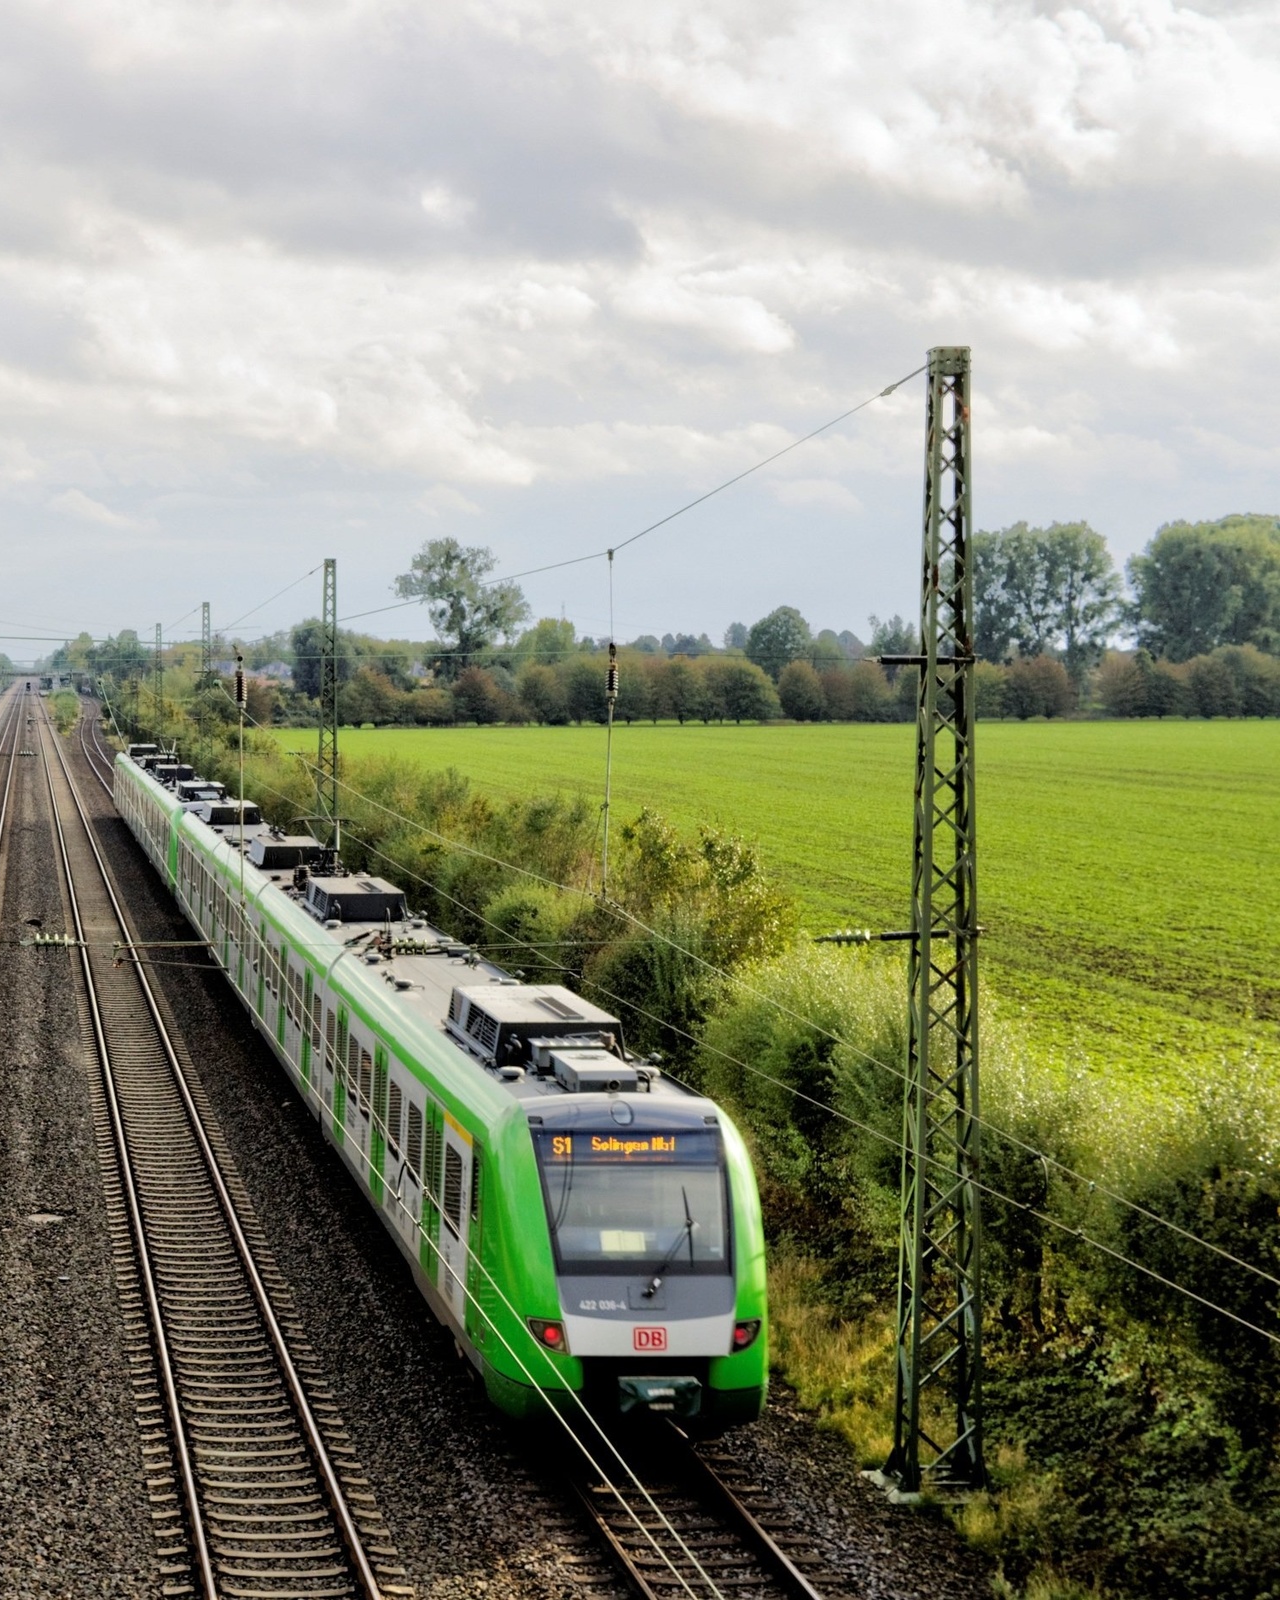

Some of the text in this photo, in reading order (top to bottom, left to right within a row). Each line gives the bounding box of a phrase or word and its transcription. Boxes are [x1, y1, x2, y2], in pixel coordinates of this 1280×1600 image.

[552, 1136, 572, 1154] S1
[591, 1136, 649, 1154] Solingen
[579, 1299, 597, 1310] 422
[637, 1331, 663, 1347] DB
